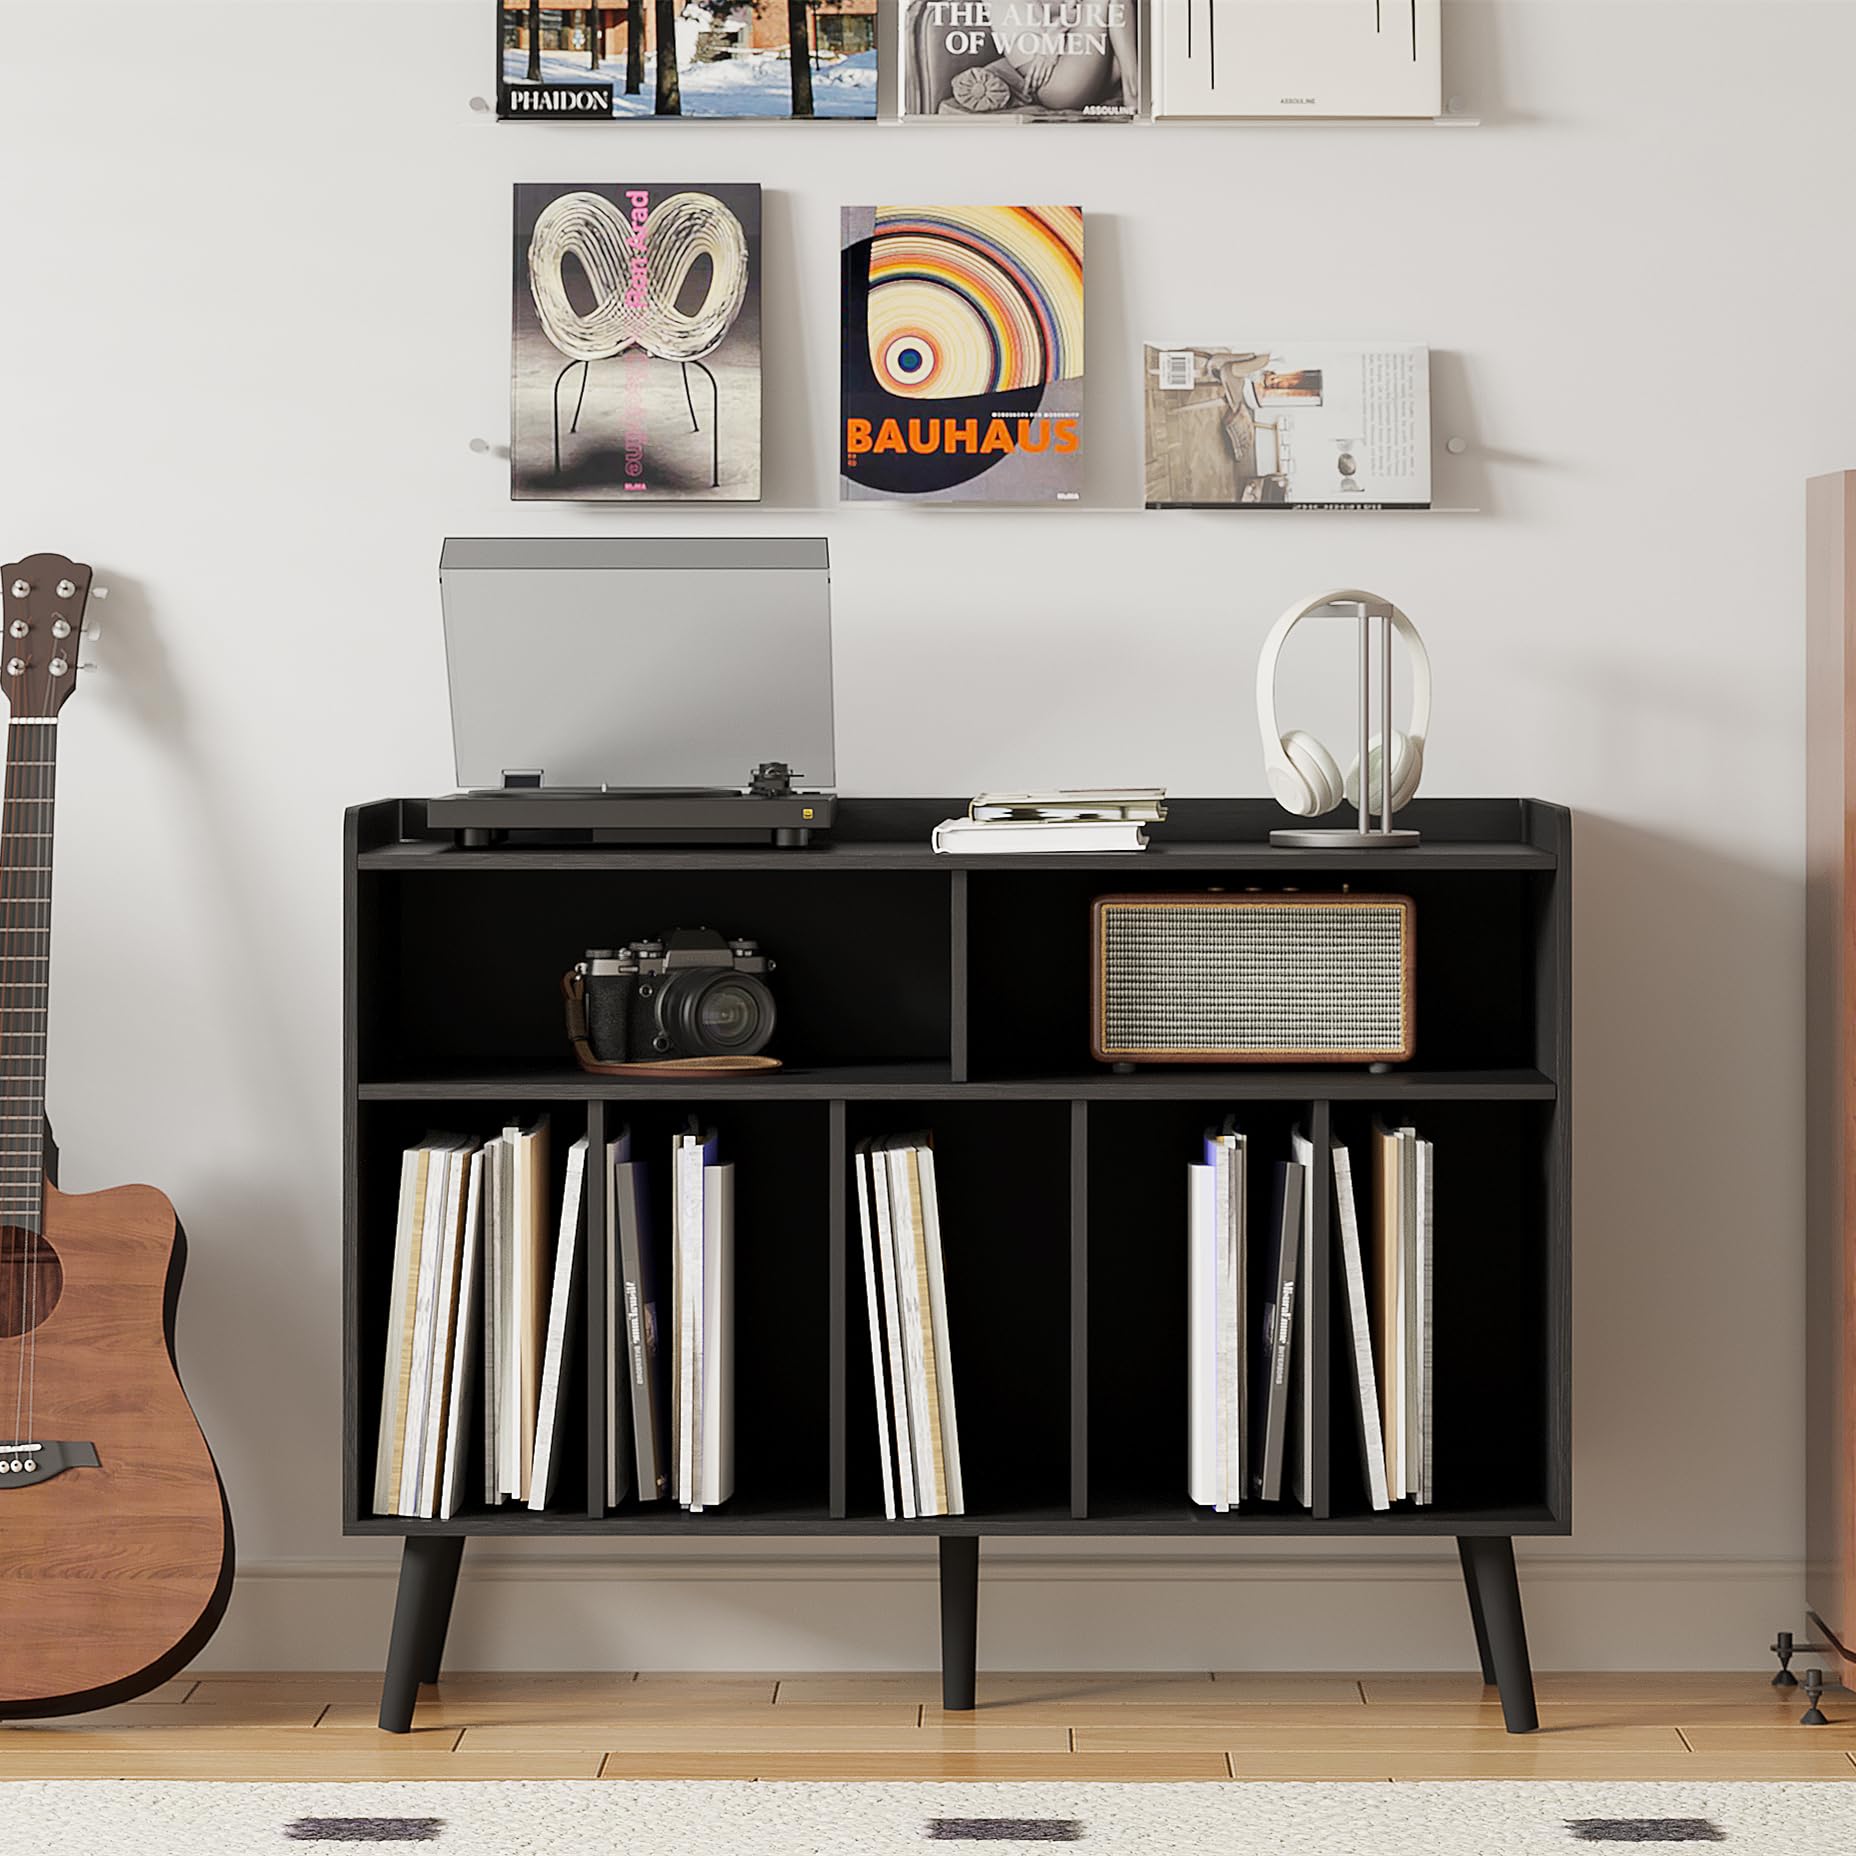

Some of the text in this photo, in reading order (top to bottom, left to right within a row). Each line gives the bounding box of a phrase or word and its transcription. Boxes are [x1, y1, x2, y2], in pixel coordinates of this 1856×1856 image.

[927, 1, 1127, 29] THE ALLURE
[945, 31, 1108, 56] OF WOMEN
[510, 90, 609, 111] PHAIDON
[625, 190, 649, 252] Arad
[847, 417, 1081, 455] BAUHAUS
